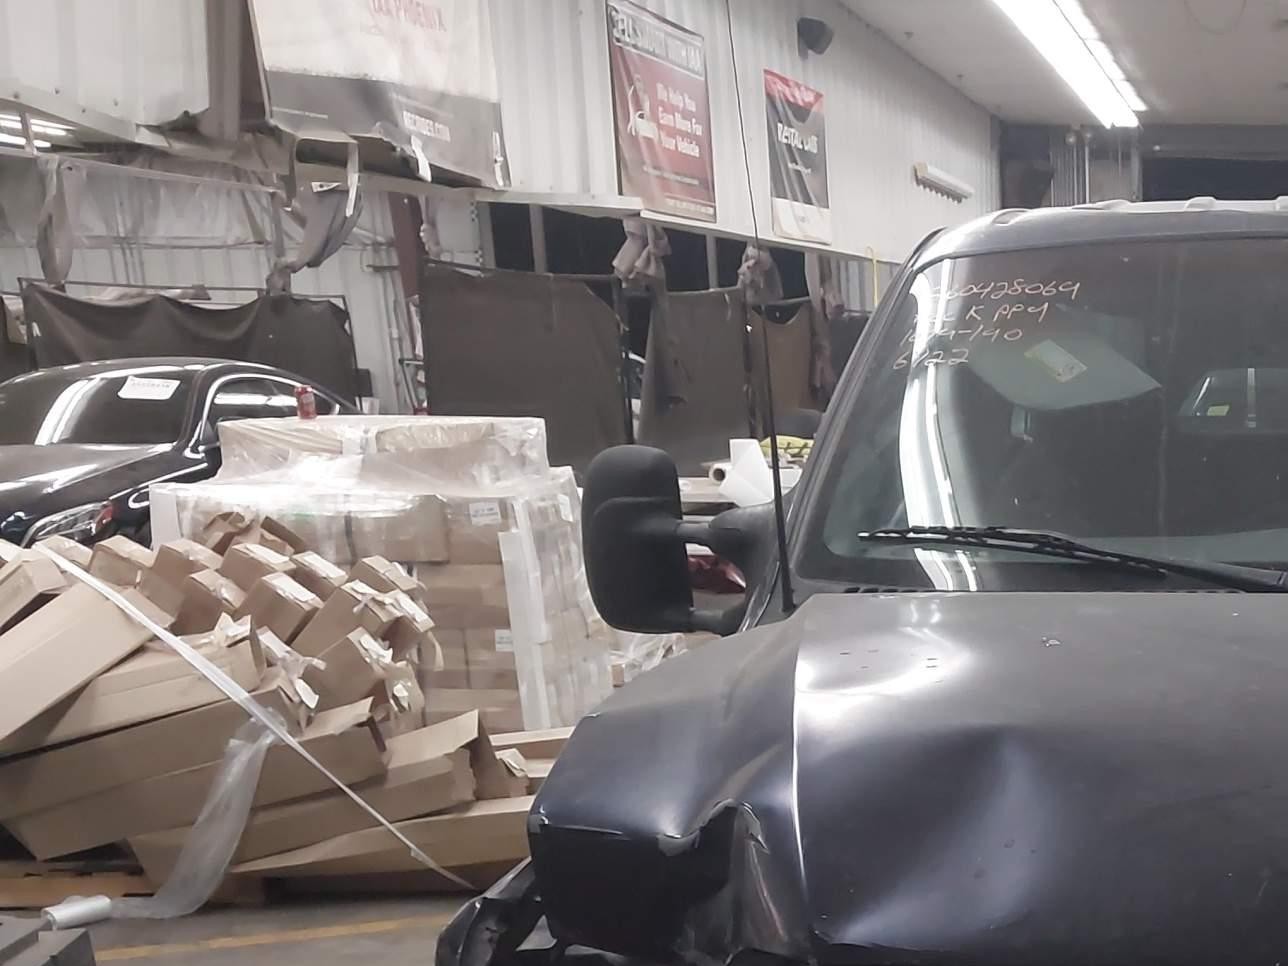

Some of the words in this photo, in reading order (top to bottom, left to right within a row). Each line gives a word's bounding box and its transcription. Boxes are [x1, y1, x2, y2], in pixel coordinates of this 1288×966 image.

[668, 86, 684, 108] Help
[691, 117, 702, 136] For
[676, 135, 700, 158] Vehicle
